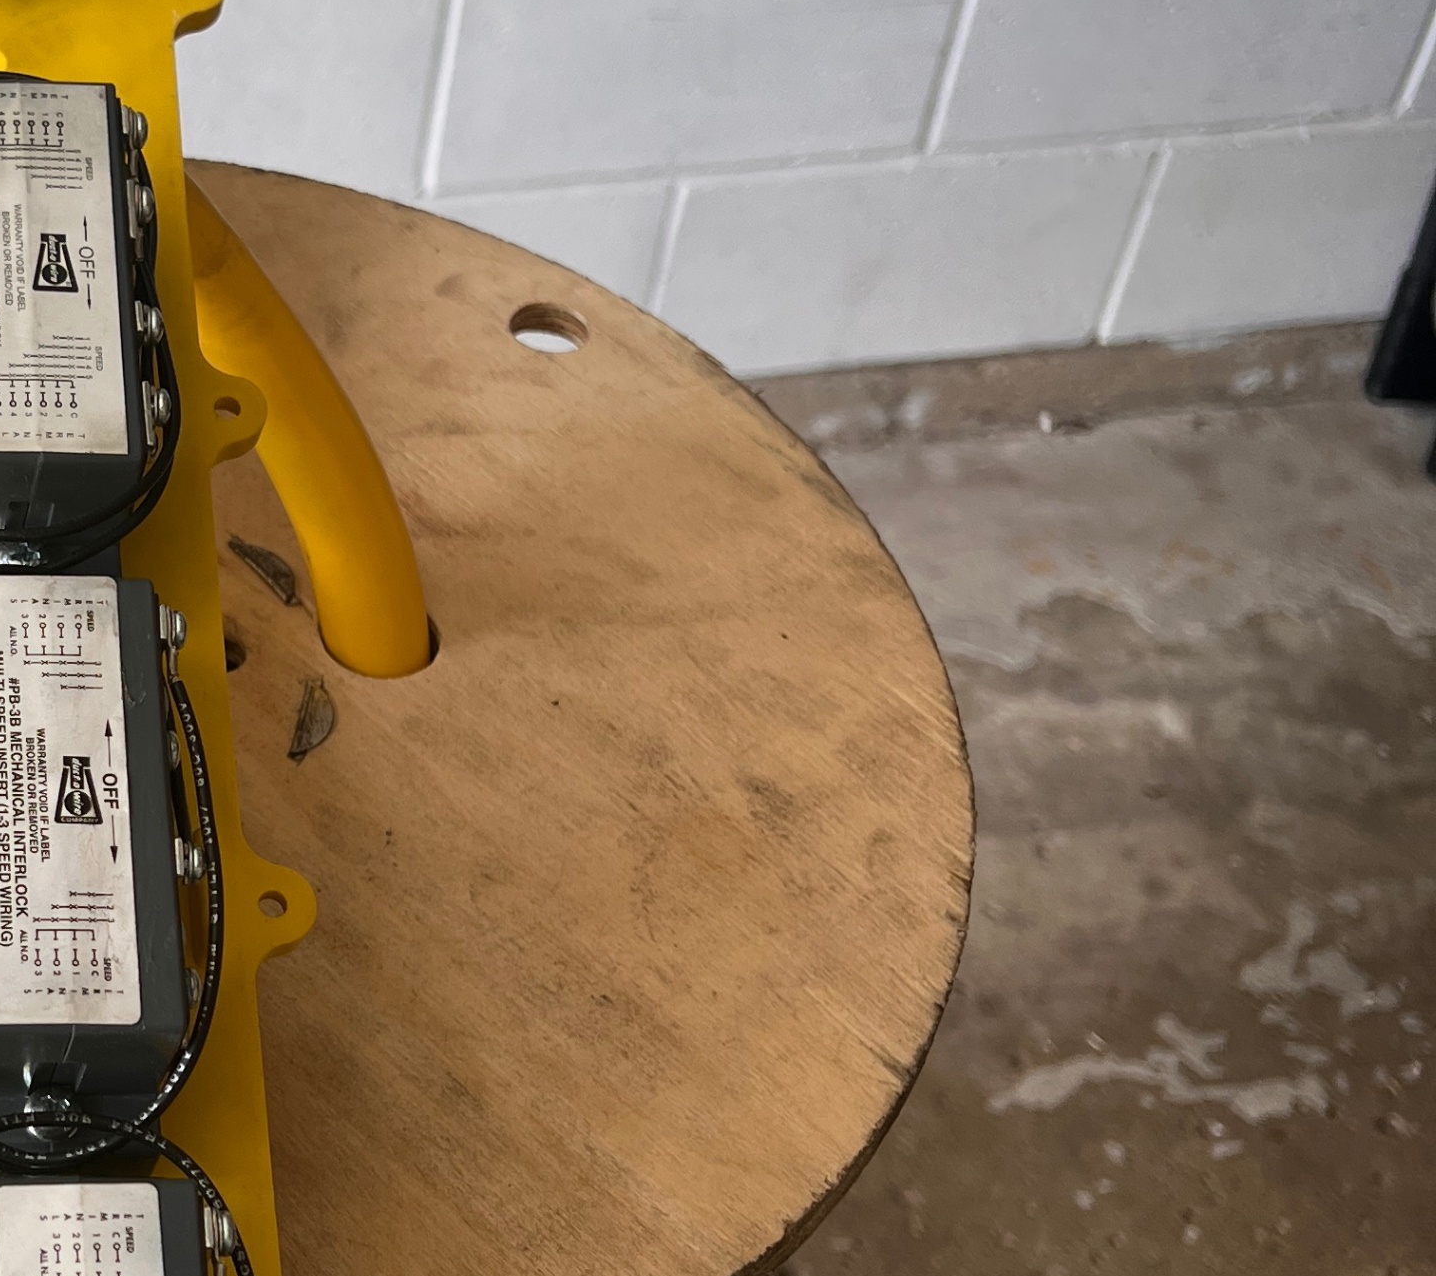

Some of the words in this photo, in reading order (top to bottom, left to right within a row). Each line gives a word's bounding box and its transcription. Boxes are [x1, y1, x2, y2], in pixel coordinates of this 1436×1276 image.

[1, 211, 10, 246] BROKEN
[13, 203, 23, 251] WARRANTY
[3, 249, 11, 261] OR
[15, 253, 24, 274] VOID
[77, 246, 95, 279] OFF
[3, 263, 13, 305] REMOVED
[16, 276, 24, 284] IF
[16, 287, 25, 312] LABEL
[8, 677, 21, 726] #PB-3B
[25, 737, 35, 779] BROKEN
[36, 728, 47, 785] WARRANTY
[10, 731, 24, 826] MECHANICAL
[27, 783, 36, 798] OR
[102, 773, 118, 809] OFF
[38, 788, 47, 812] VOID
[27, 802, 38, 853] REMOVED
[39, 815, 48, 824] IF
[39, 827, 49, 862] LABEL
[13, 830, 28, 917] INTERLOCK
